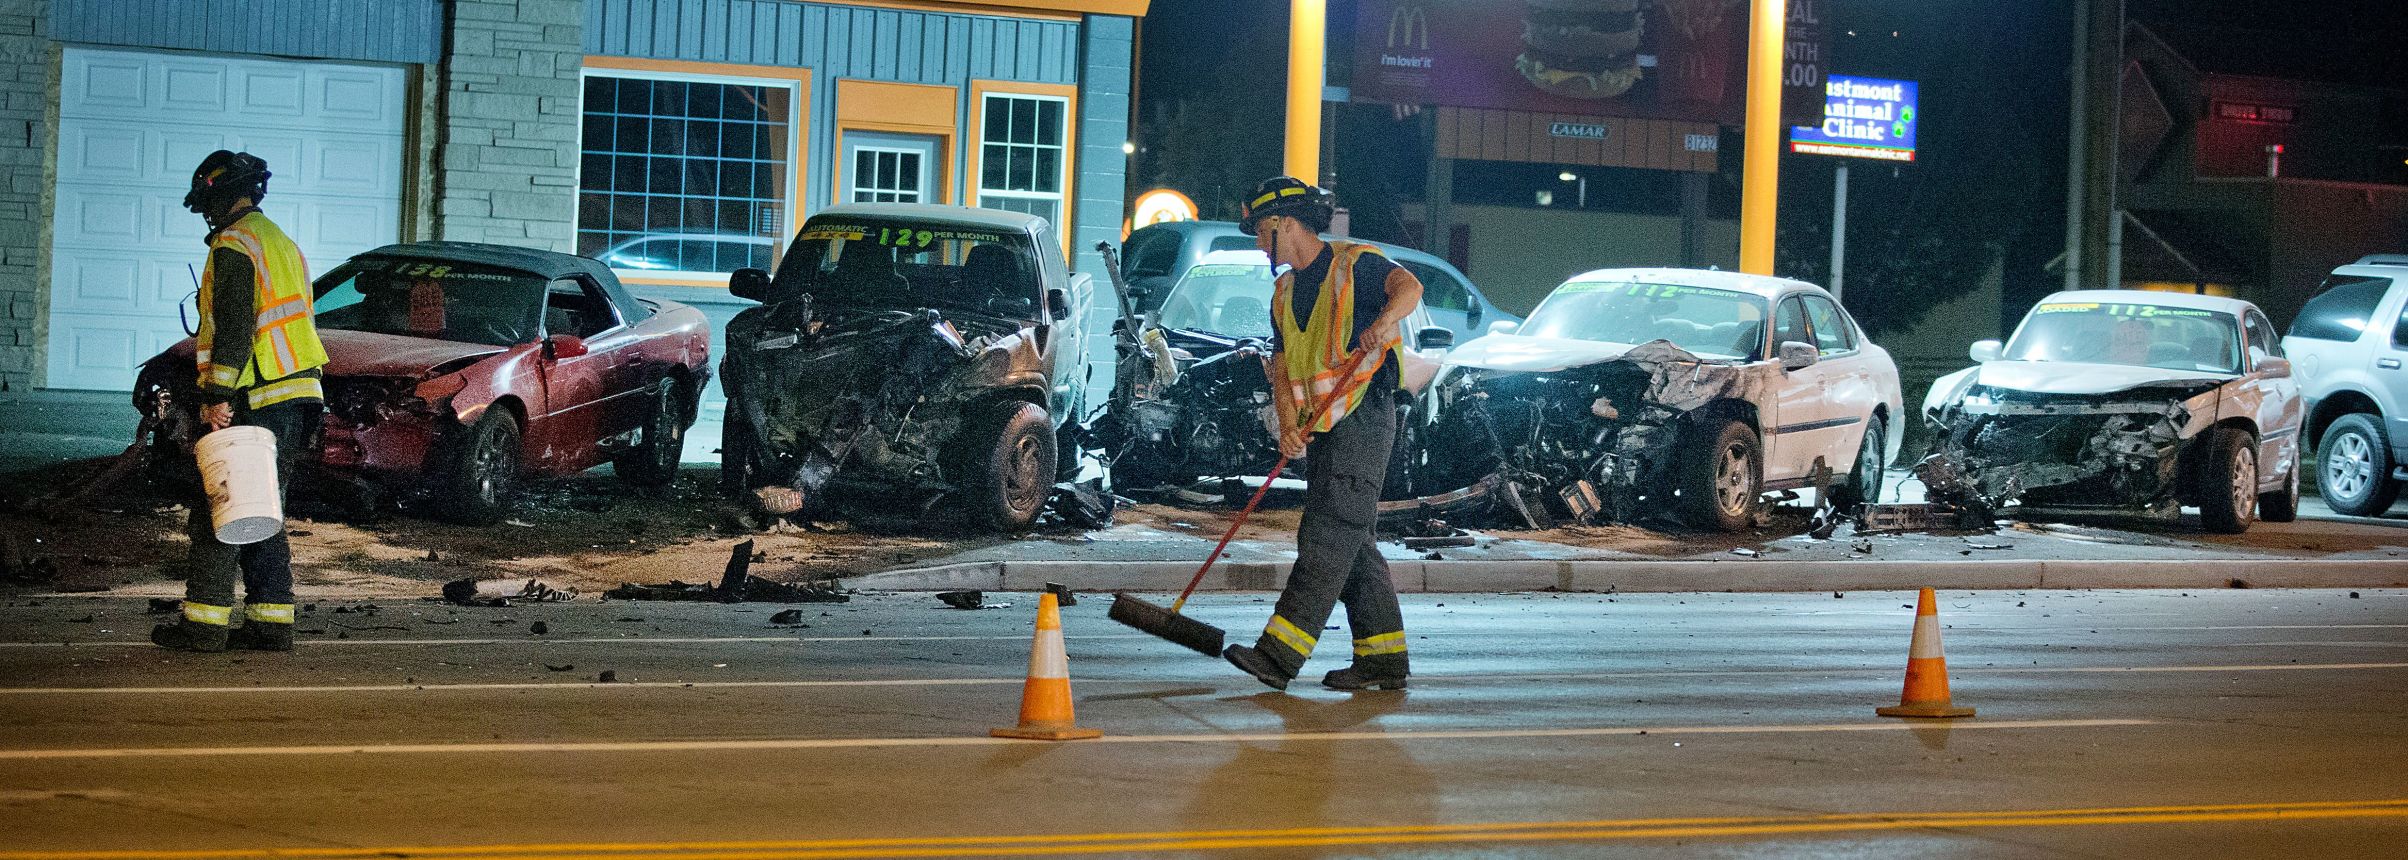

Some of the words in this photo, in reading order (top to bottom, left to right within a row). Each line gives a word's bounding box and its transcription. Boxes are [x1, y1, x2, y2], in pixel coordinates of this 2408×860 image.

[1381, 54, 1396, 66] i'm
[1423, 56, 1432, 68] it
[1785, 42, 1818, 61] NTH
[1785, 63, 1818, 87] .00
[1826, 80, 1903, 102] stmont
[1551, 124, 1605, 138] LAMAR
[1822, 117, 1885, 141] Clinic
[809, 224, 869, 233] AUTOMATIC
[879, 227, 934, 248] 129
[934, 231, 954, 239] PER
[956, 232, 1000, 242] MONTH
[395, 263, 453, 278] 138
[467, 273, 512, 282] MONTH
[1627, 284, 1680, 298] 112
[1698, 288, 1739, 298] MONTH
[2108, 304, 2156, 317] 112
